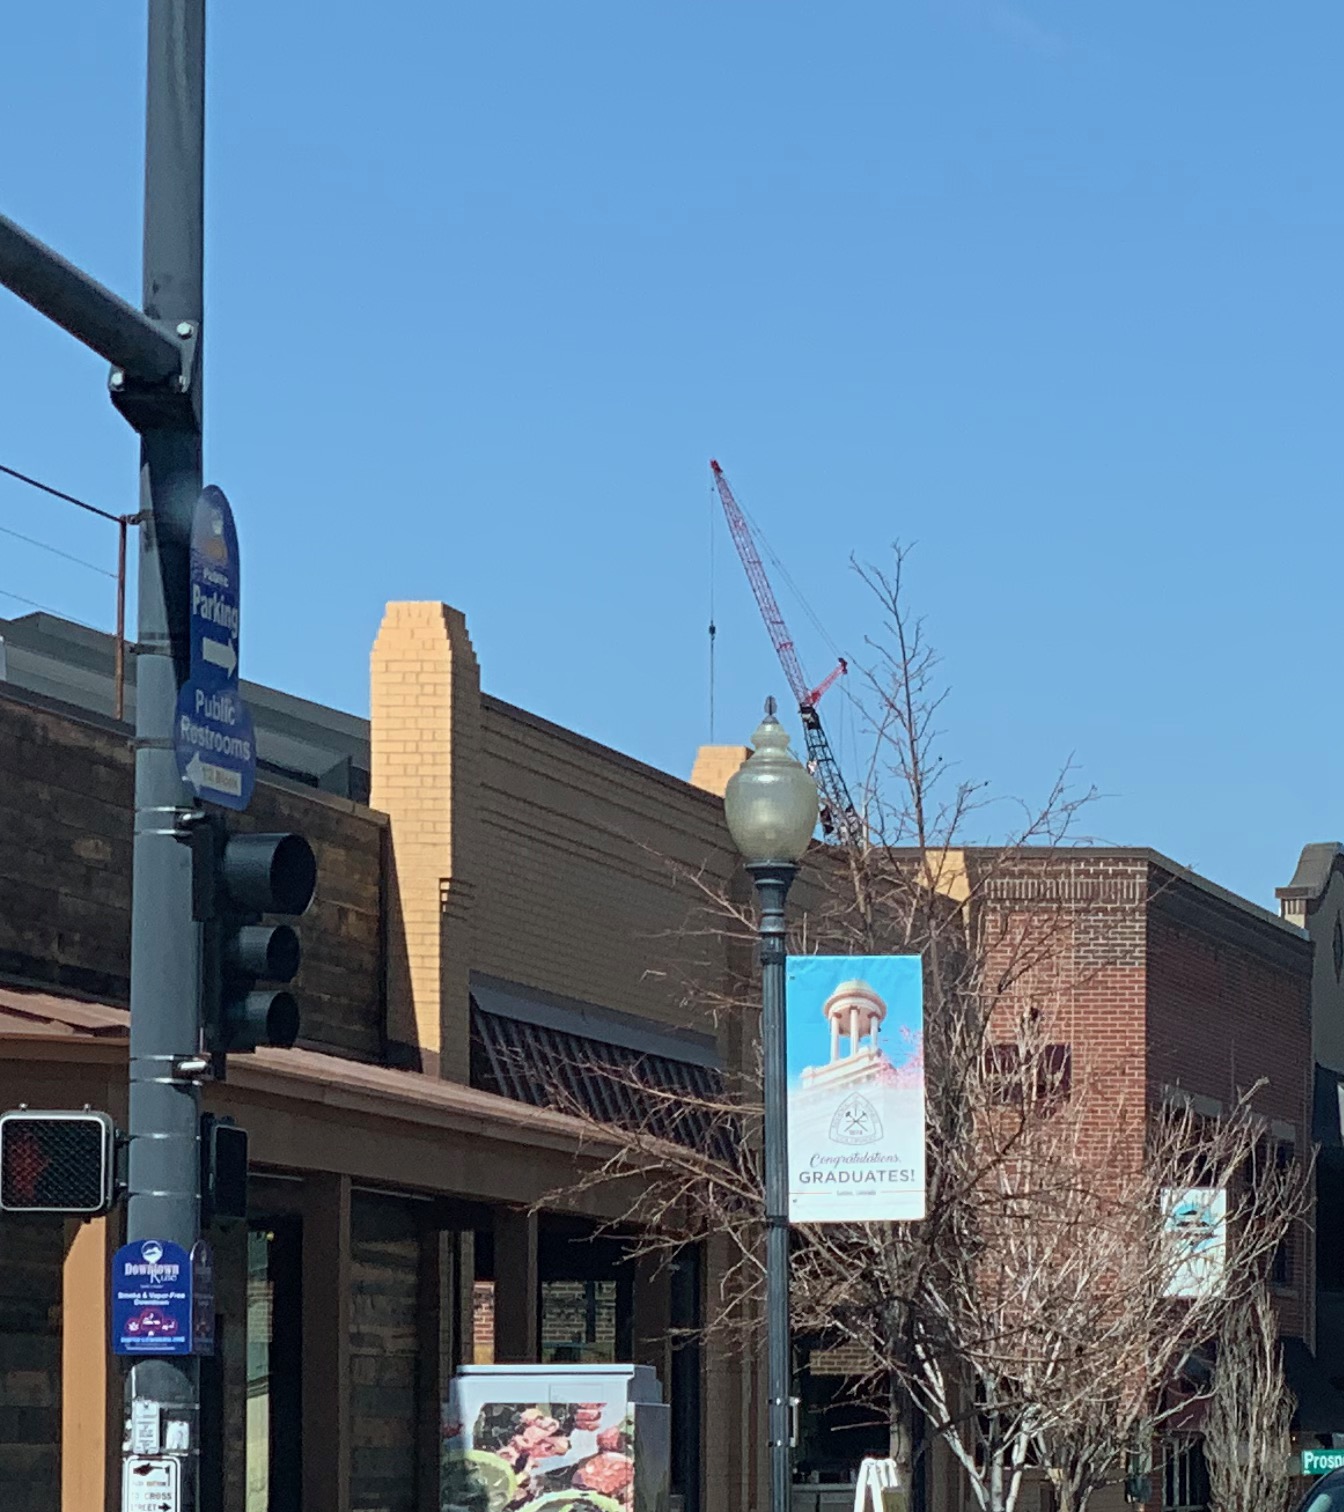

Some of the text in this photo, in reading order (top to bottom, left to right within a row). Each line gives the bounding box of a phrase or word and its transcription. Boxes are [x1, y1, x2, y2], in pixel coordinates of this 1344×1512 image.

[192, 583, 239, 639] Parking
[195, 688, 236, 726] Public
[181, 714, 251, 761] Restrooms
[799, 1169, 915, 1184] GRADUATES!
[144, 1492, 172, 1500] CROSS
